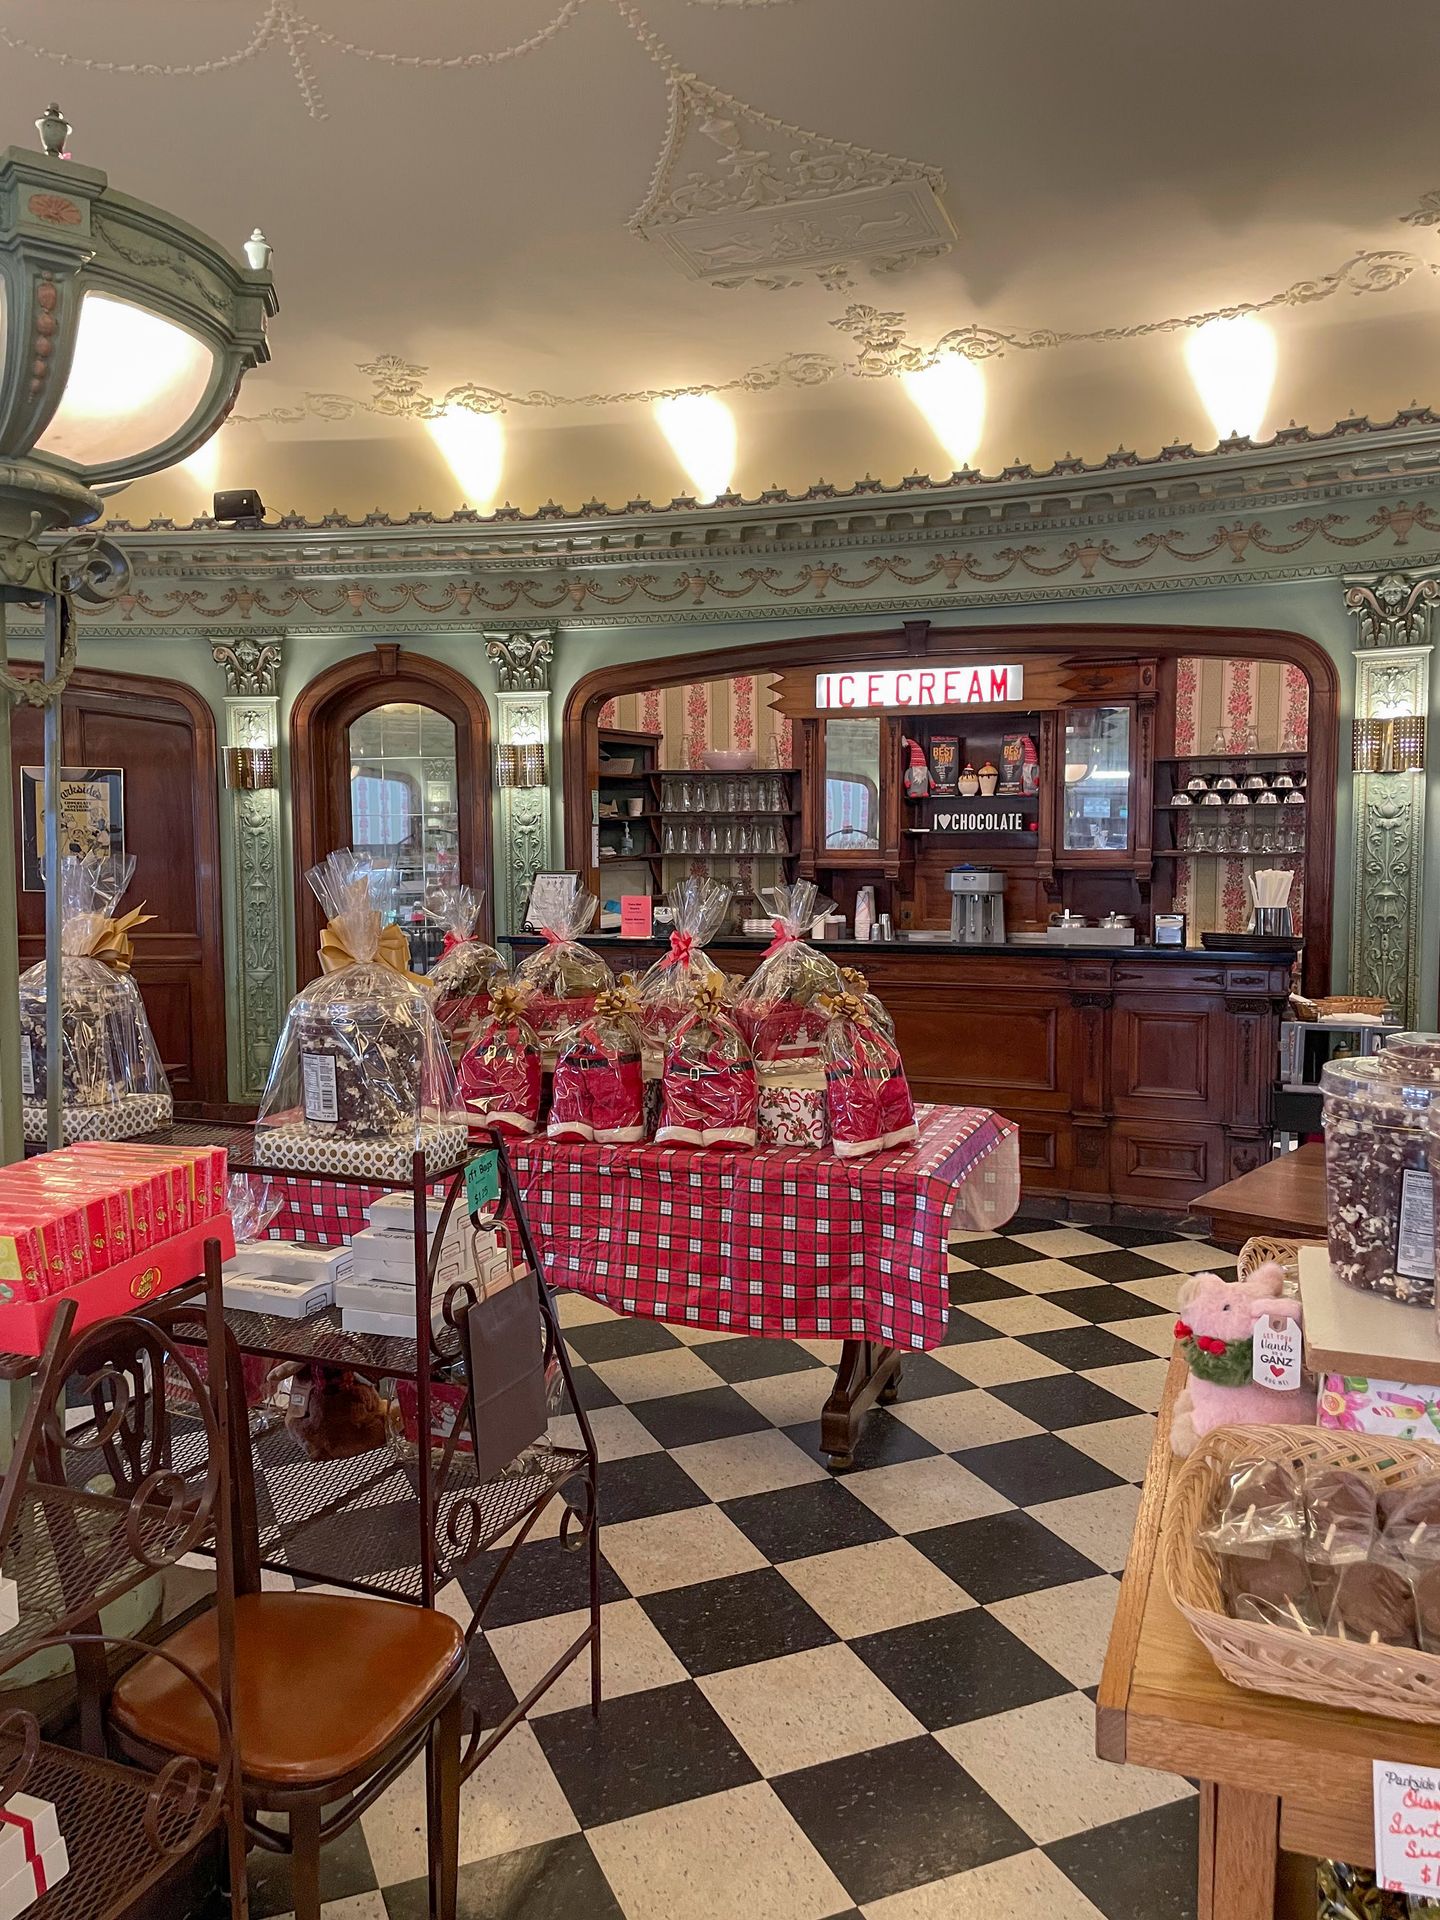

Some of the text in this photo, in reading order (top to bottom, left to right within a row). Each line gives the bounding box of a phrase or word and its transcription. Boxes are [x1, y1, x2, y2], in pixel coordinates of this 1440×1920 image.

[826, 668, 1008, 708] ICE CREAM
[932, 746, 955, 759] BEST
[952, 813, 1022, 830] CHOCOLATE
[1260, 1354, 1293, 1367] GANZ
[1385, 1771, 1435, 1793] Parkside
